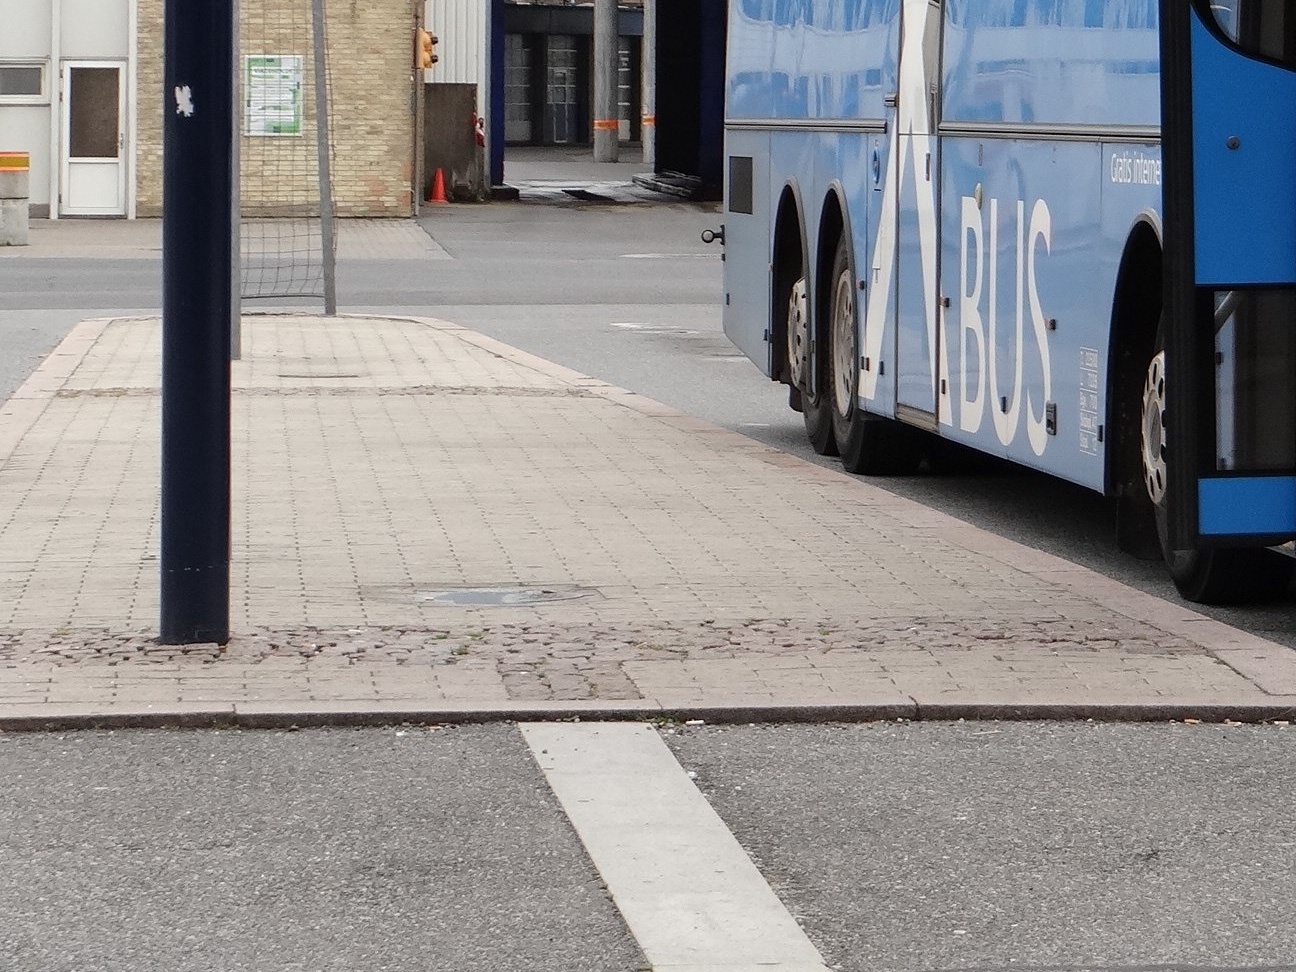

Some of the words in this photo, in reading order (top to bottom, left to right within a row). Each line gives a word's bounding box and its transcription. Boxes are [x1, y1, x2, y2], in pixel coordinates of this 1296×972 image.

[1110, 151, 1132, 183] Gratis
[1132, 151, 1161, 185] interne
[959, 194, 1052, 457] BUS
